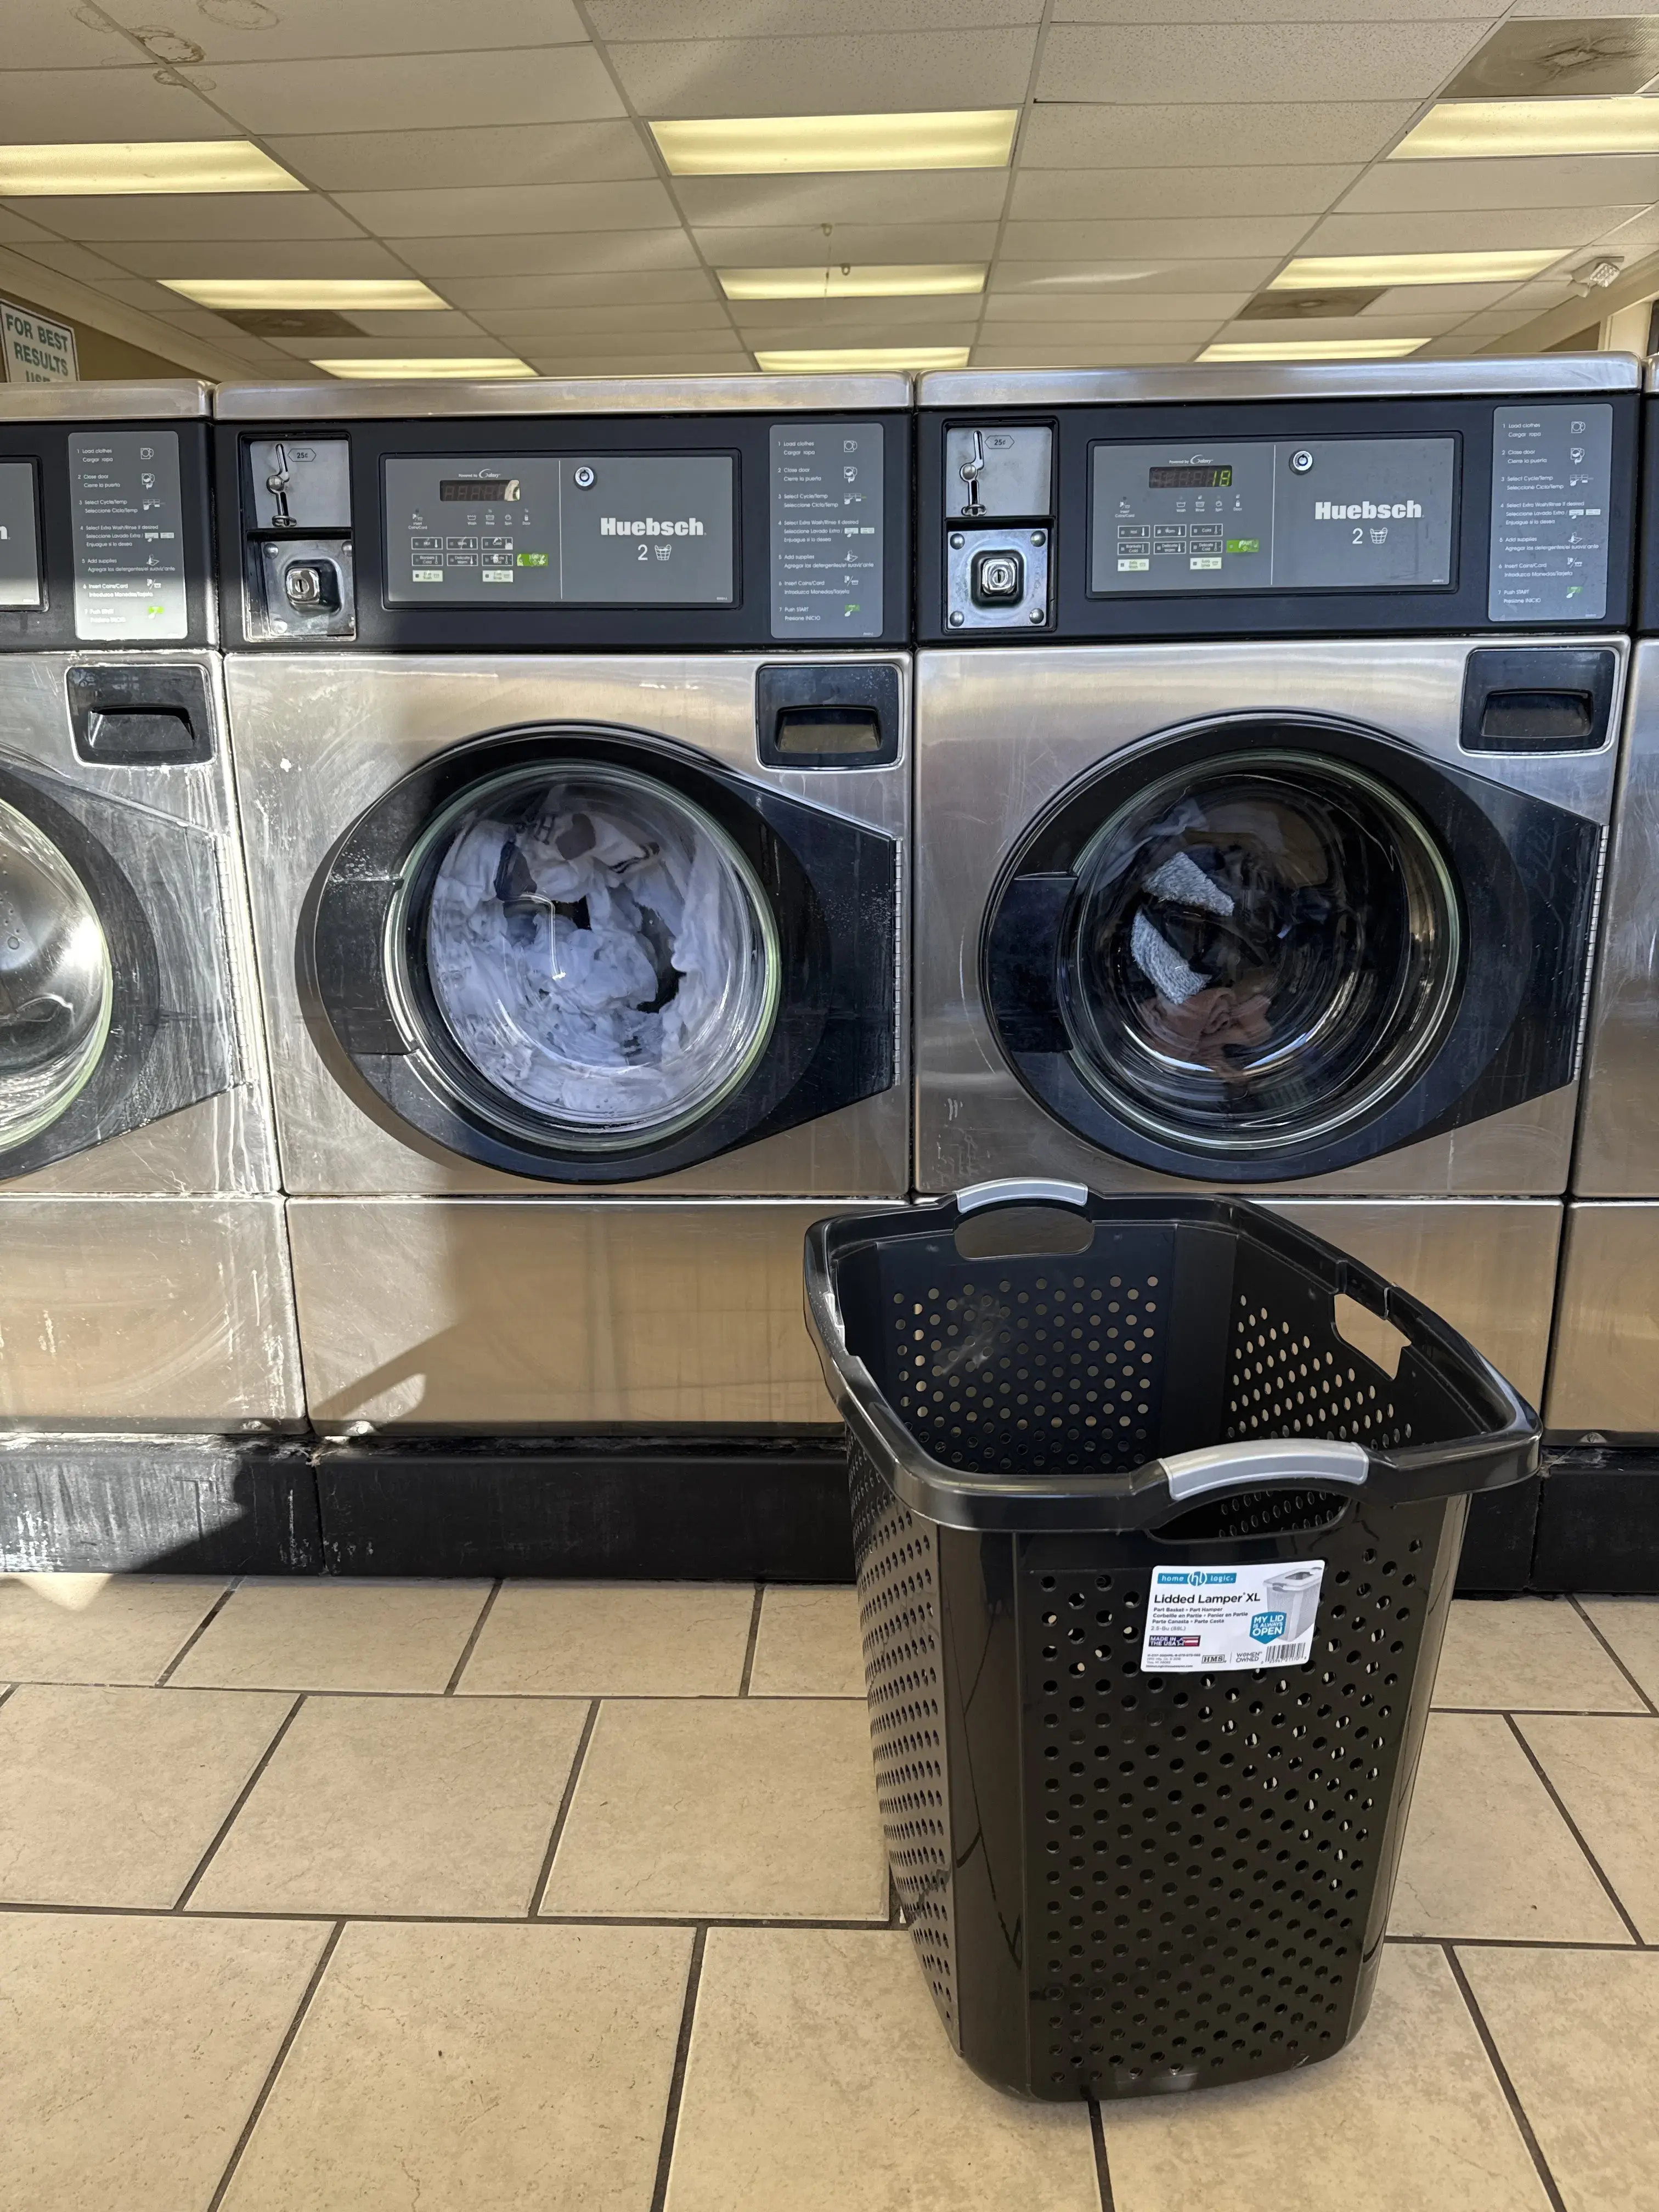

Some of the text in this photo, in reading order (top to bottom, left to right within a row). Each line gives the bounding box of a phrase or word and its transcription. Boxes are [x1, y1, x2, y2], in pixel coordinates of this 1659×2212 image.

[5, 313, 68, 353] FOR BEST
[13, 341, 68, 377] RESULTS
[1213, 470, 1231, 487] 18
[1315, 500, 1421, 520] Huebsch
[601, 518, 703, 535] Huebsch
[1352, 528, 1363, 544] 2
[638, 544, 648, 560] 2
[1154, 1593, 1261, 1604] Lidded Lamper XL
[1252, 1627, 1283, 1636] OPEN
